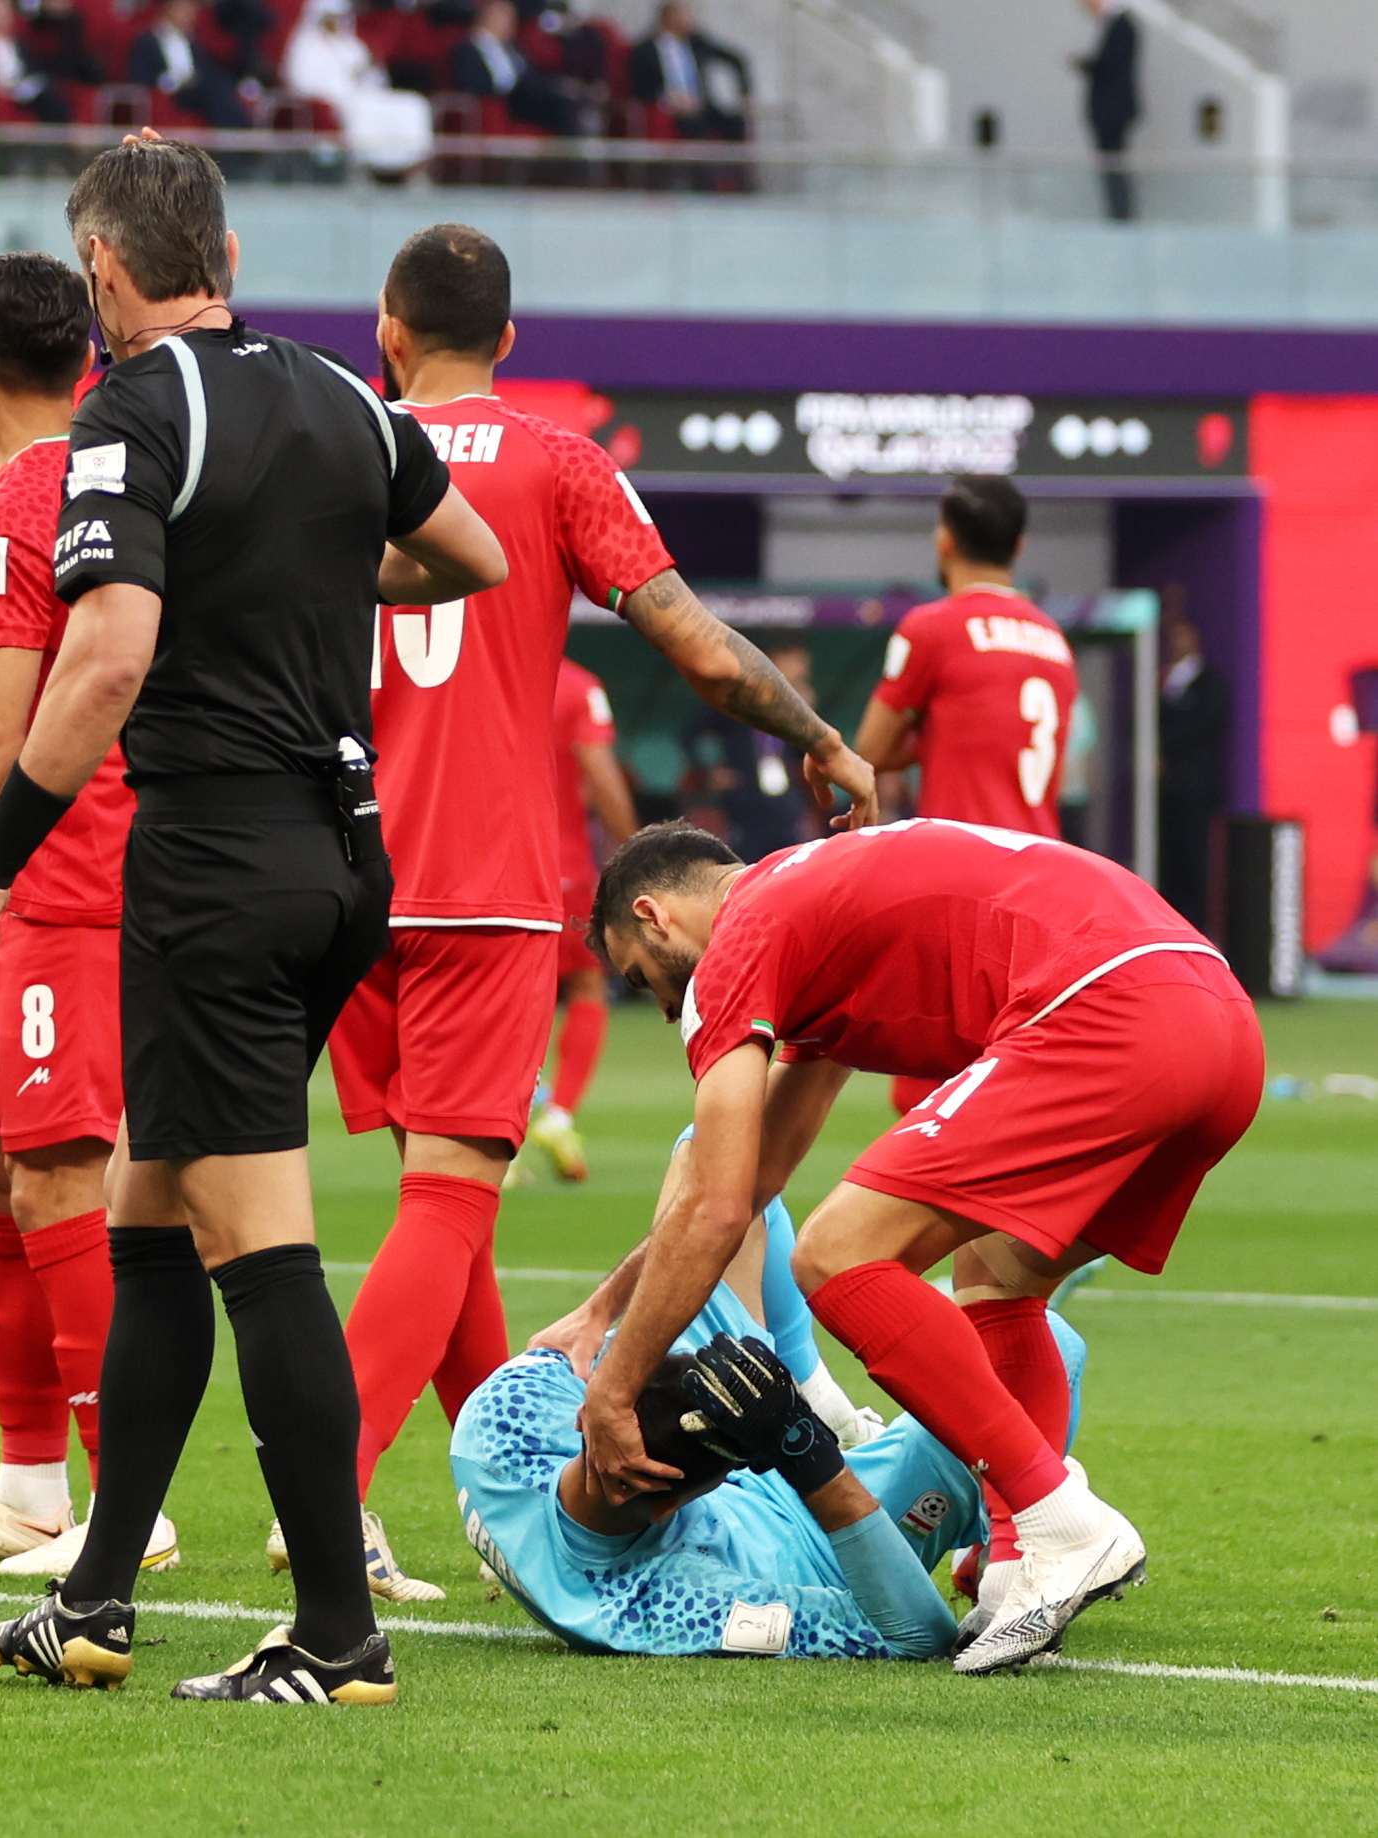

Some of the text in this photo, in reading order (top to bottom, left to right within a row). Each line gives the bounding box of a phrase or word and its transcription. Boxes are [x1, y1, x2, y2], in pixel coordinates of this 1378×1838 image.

[419, 423, 504, 463] BEH
[53, 520, 112, 561] FIFA
[54, 547, 115, 577] TEAM ONE
[1018, 676, 1059, 808] 3
[22, 984, 56, 1059] 8
[909, 1056, 1000, 1120] 1
